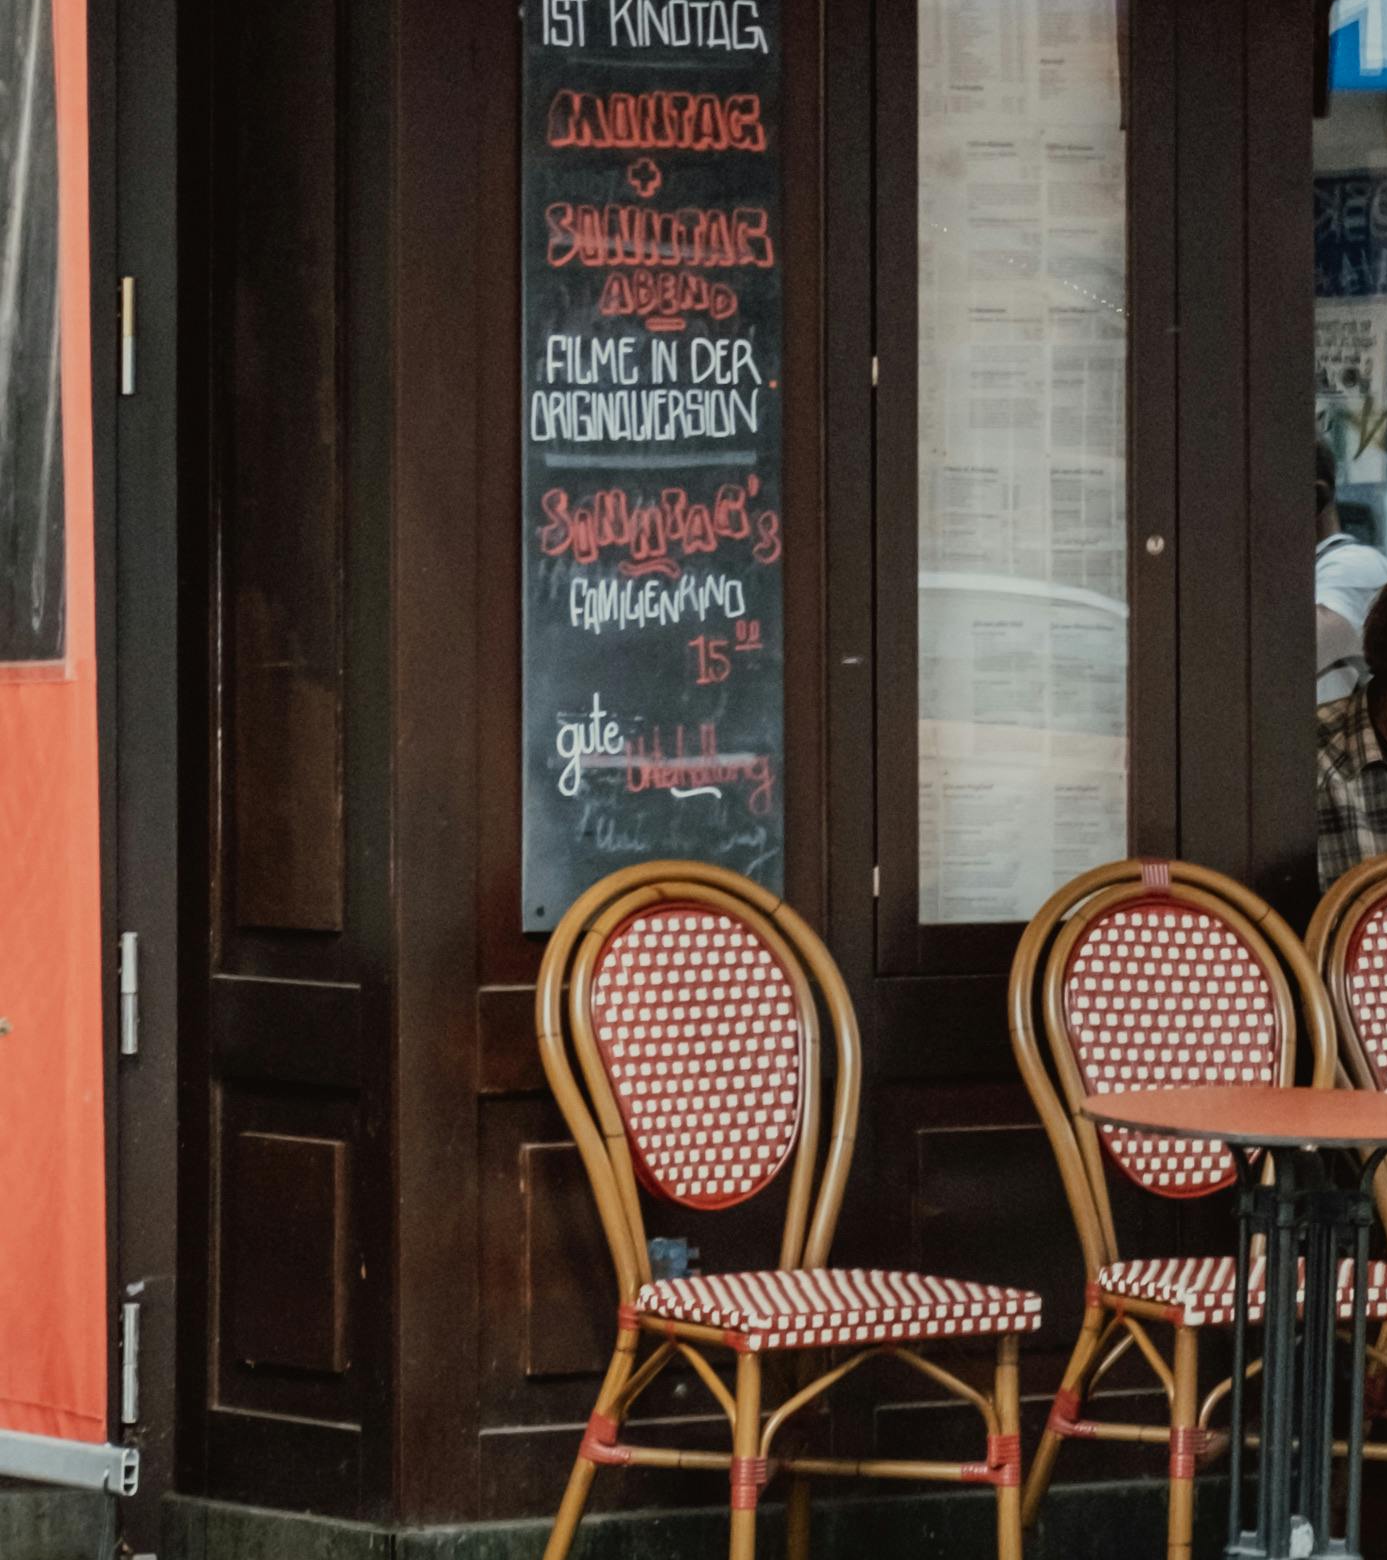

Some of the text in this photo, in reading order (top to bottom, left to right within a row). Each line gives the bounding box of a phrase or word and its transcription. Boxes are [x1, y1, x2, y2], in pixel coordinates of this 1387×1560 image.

[548, 89, 766, 151] MONTAG
[546, 203, 774, 268] SONNTAG
[600, 269, 737, 319] ABEND
[547, 335, 762, 385] FILME IN DER
[531, 388, 759, 441] ORIGINALVERSION
[570, 574, 745, 634] FAMILIENKINO
[556, 692, 623, 796] gute
